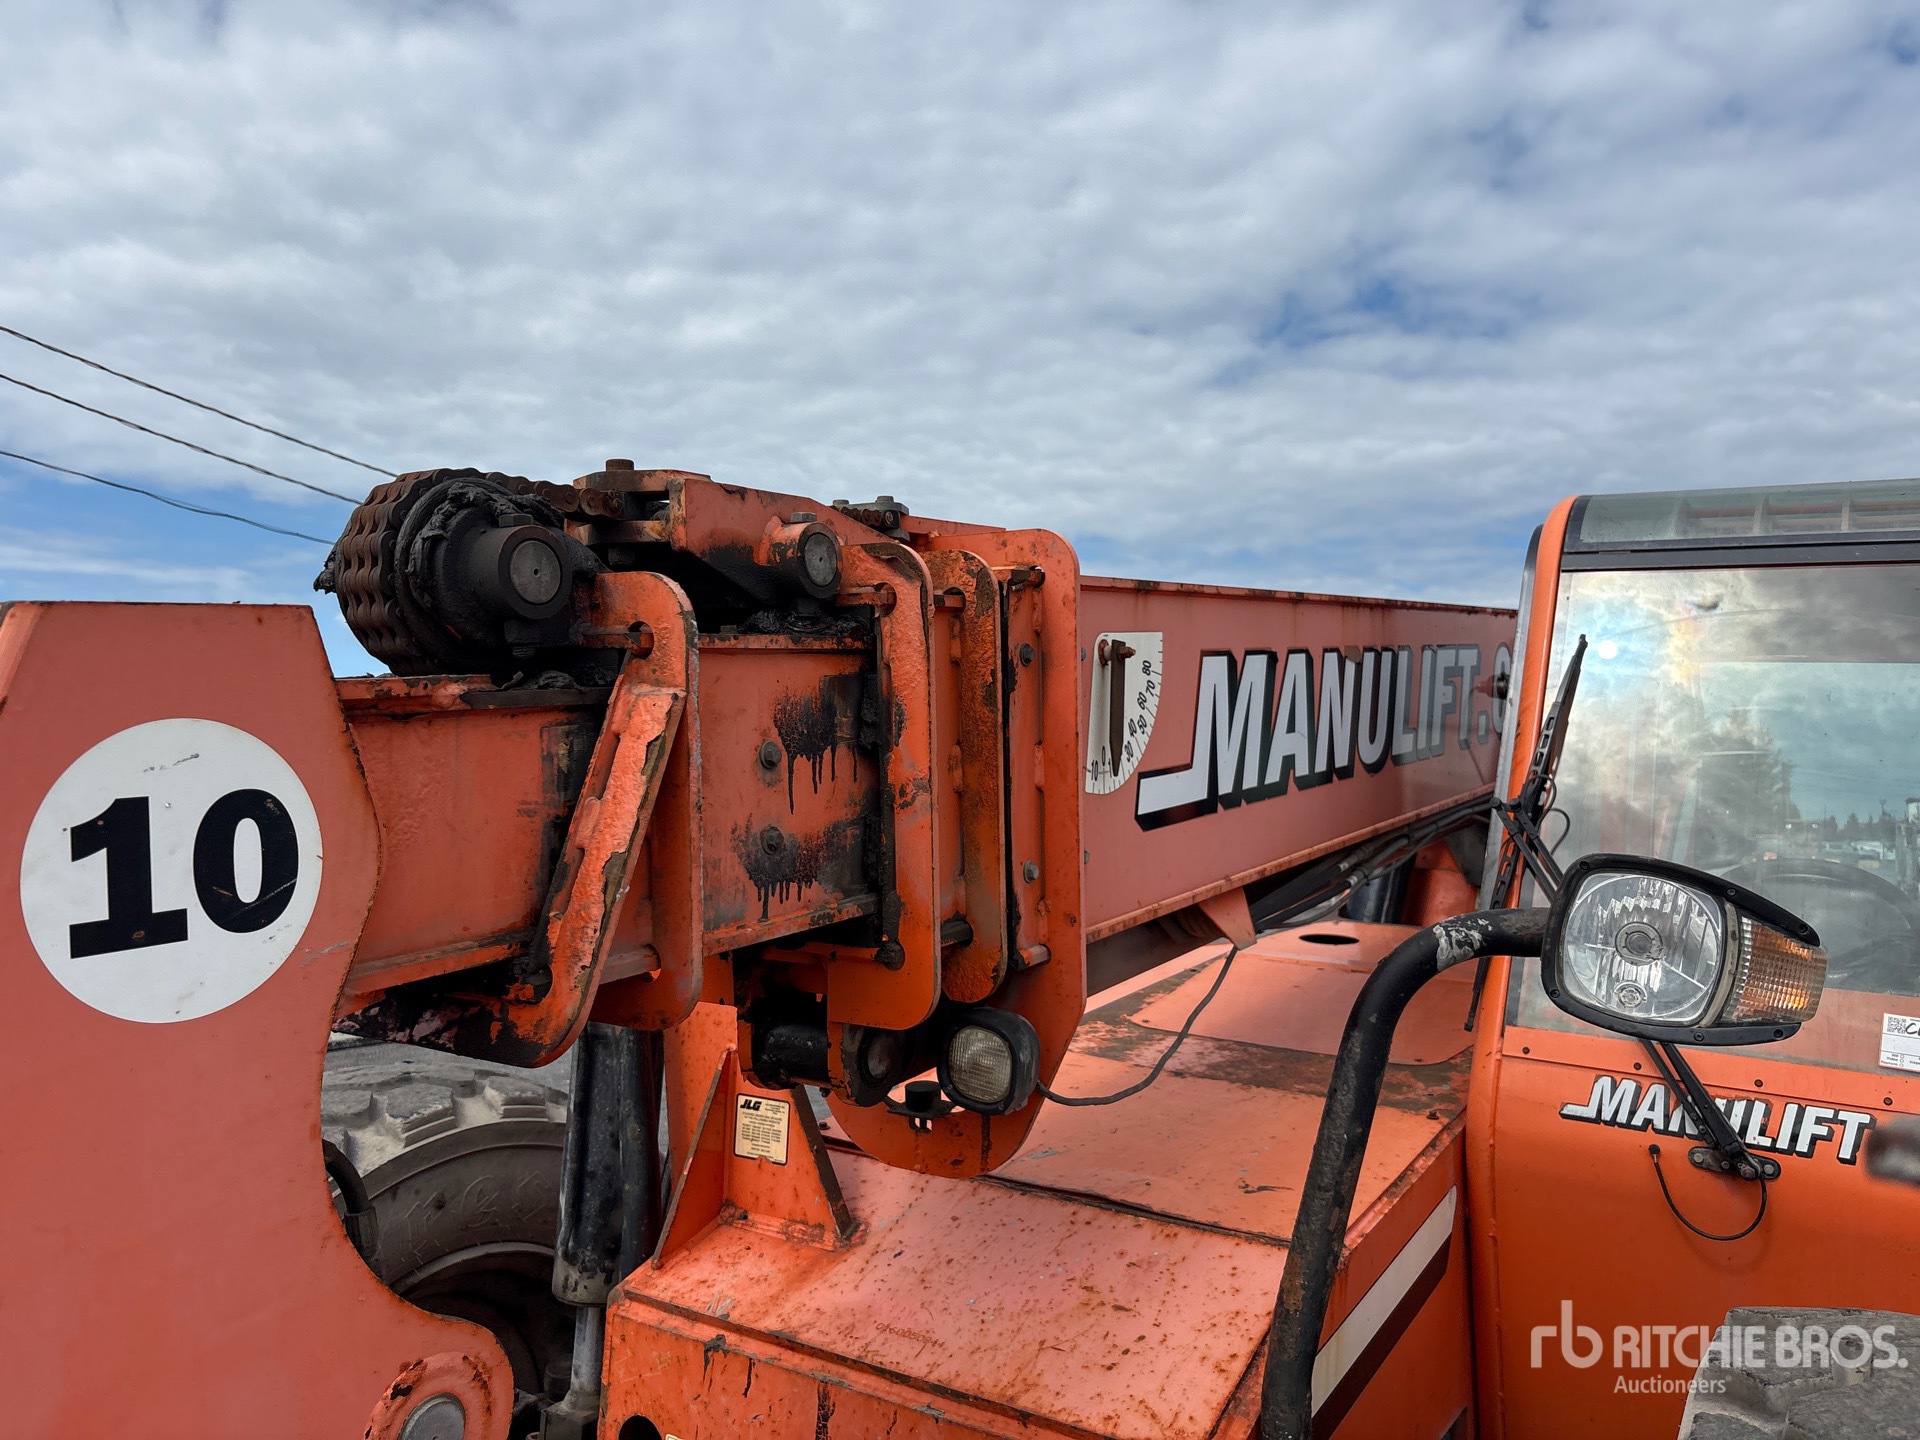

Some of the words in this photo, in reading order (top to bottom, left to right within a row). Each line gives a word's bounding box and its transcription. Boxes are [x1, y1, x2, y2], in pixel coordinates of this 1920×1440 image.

[1142, 660, 1152, 676] 80
[1145, 680, 1156, 697] 70
[1137, 691, 1147, 710] 60
[1128, 718, 1137, 738] 40
[1136, 714, 1148, 735] 50
[1101, 745, 1106, 767] 0
[1124, 740, 1134, 763] 30
[1091, 759, 1099, 782] 10
[69, 788, 299, 960] 10
[740, 1099, 762, 1111] JLG
